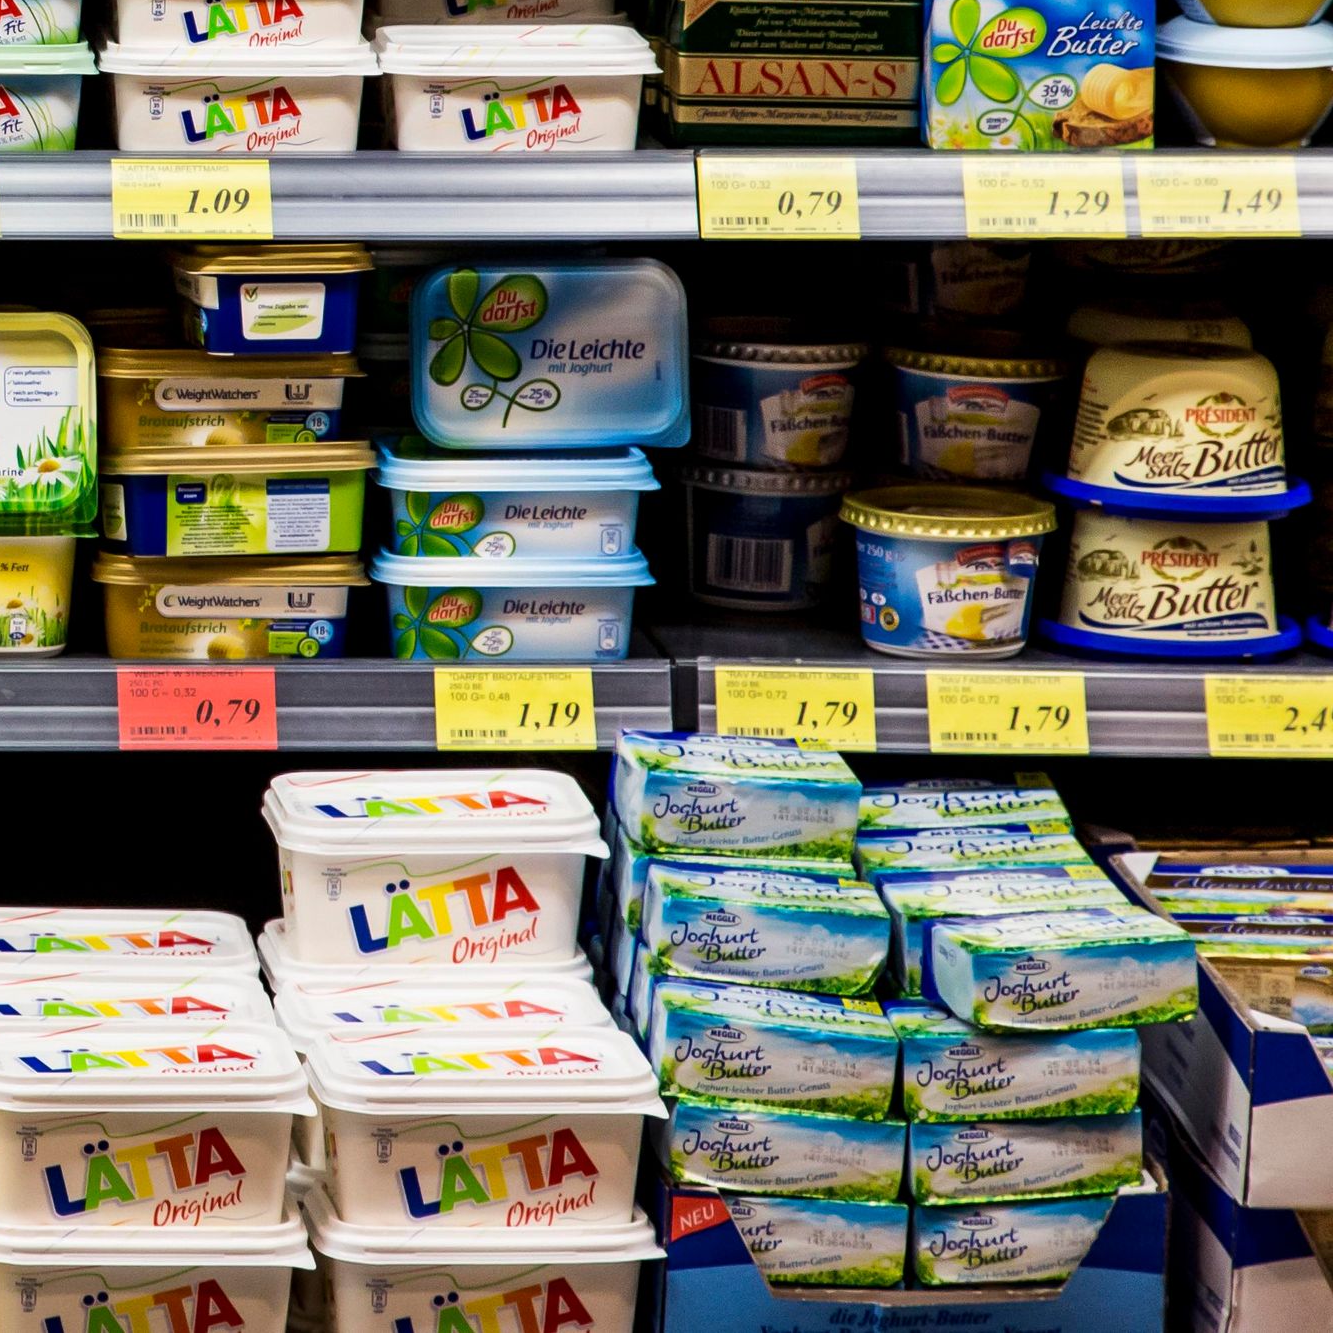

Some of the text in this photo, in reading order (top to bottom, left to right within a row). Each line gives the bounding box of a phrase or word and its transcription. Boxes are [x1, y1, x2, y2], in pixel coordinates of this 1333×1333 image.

[997, 18, 1016, 33] Du
[1079, 12, 1143, 31] Leichte
[982, 28, 1036, 49] darfst
[1048, 26, 1137, 57] Butter
[185, 188, 249, 214] 1.09
[777, 190, 842, 216] 0,79
[530, 340, 644, 360] Die Leichte
[1186, 406, 1256, 423] PRÉSIDENT
[197, 700, 260, 724] 0,79
[518, 703, 579, 729] 1,19
[796, 702, 857, 727] 1,79
[654, 797, 739, 819] Joghurt
[688, 813, 746, 834] Butter
[349, 868, 541, 955] LÄTTA
[681, 1205, 716, 1230] NEU
